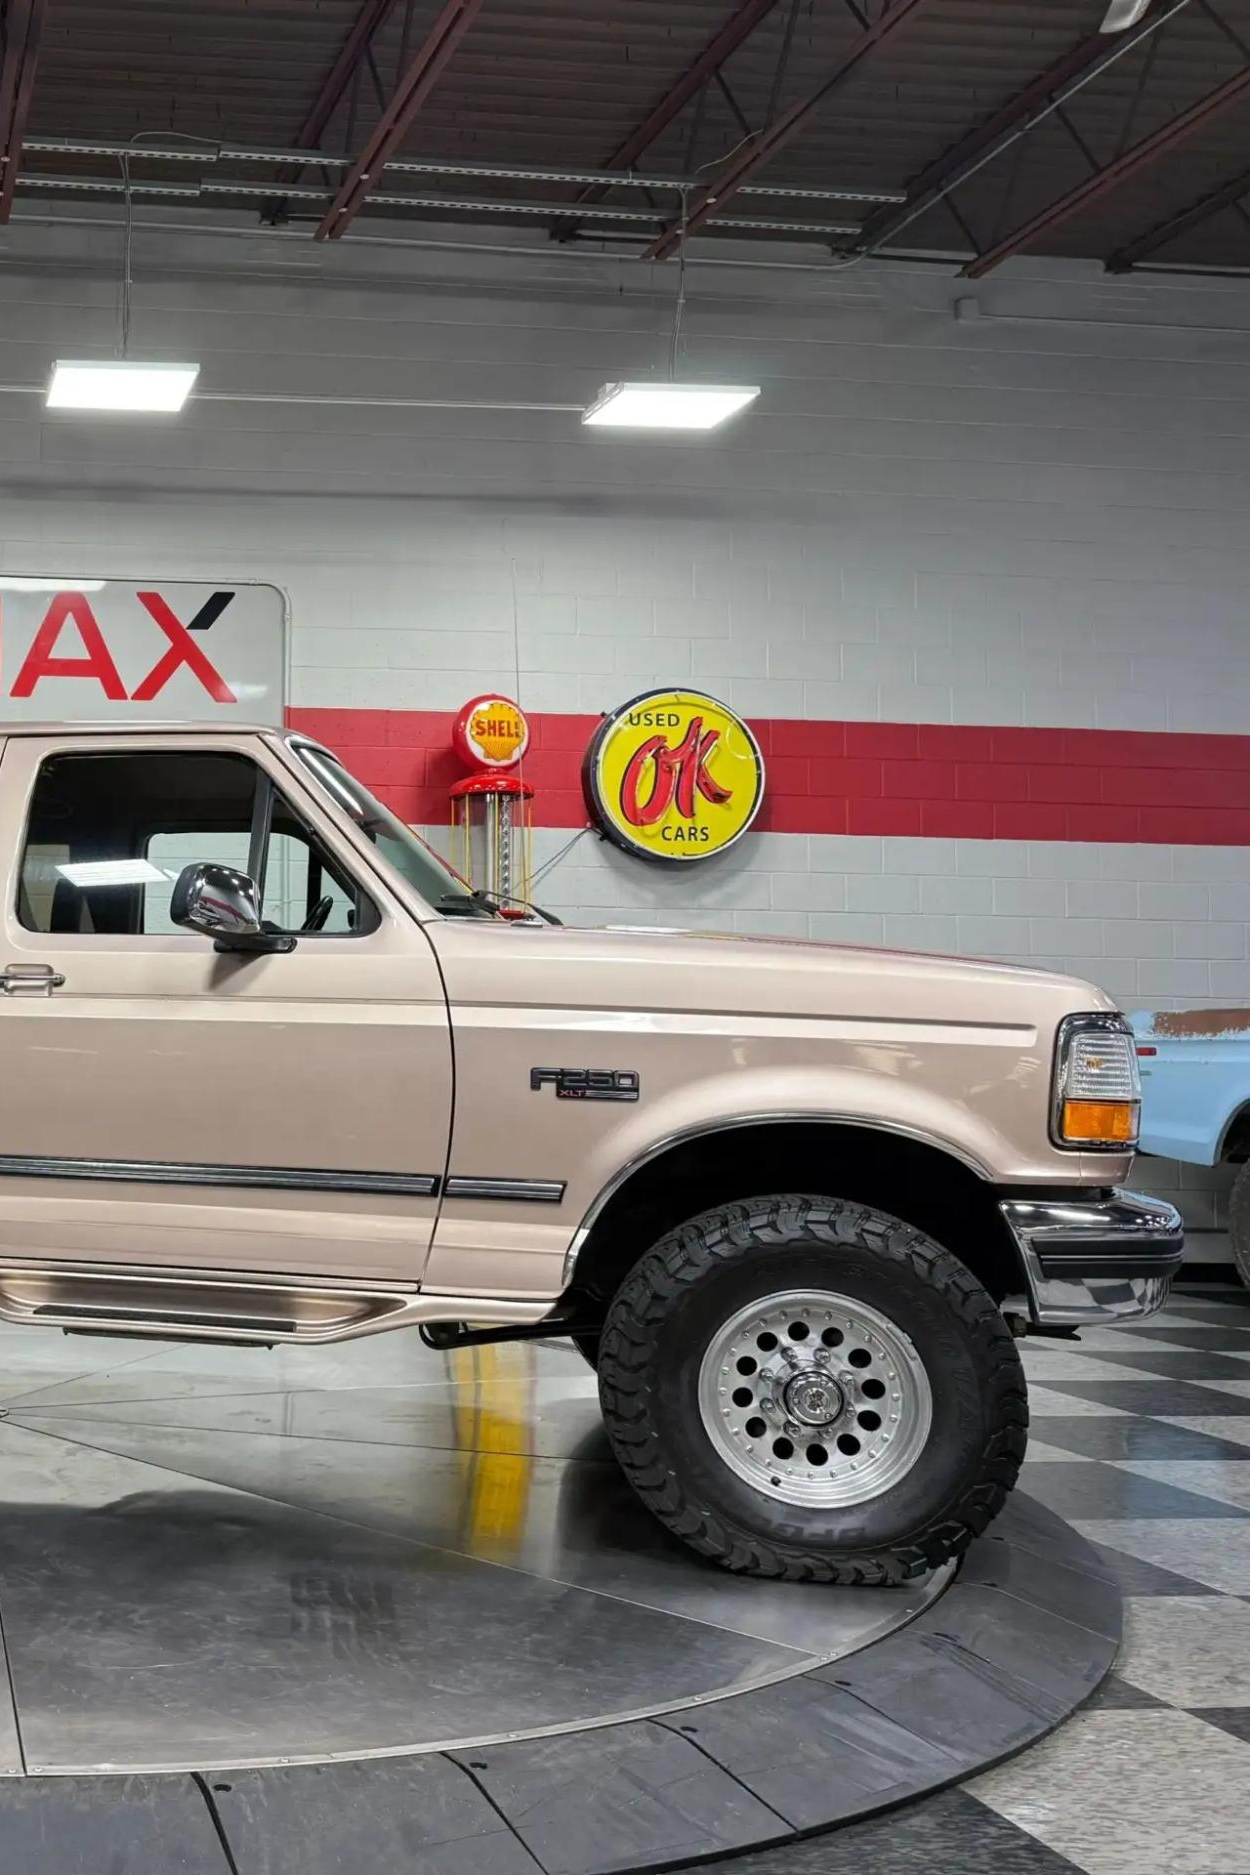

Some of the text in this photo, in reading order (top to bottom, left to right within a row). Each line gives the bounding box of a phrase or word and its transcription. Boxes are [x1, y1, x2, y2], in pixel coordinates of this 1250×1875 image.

[629, 713, 680, 727] USED
[475, 720, 519, 738] SHELL
[619, 716, 733, 827] OK
[661, 826, 709, 841] CARS
[559, 1089, 585, 1097] XLT
